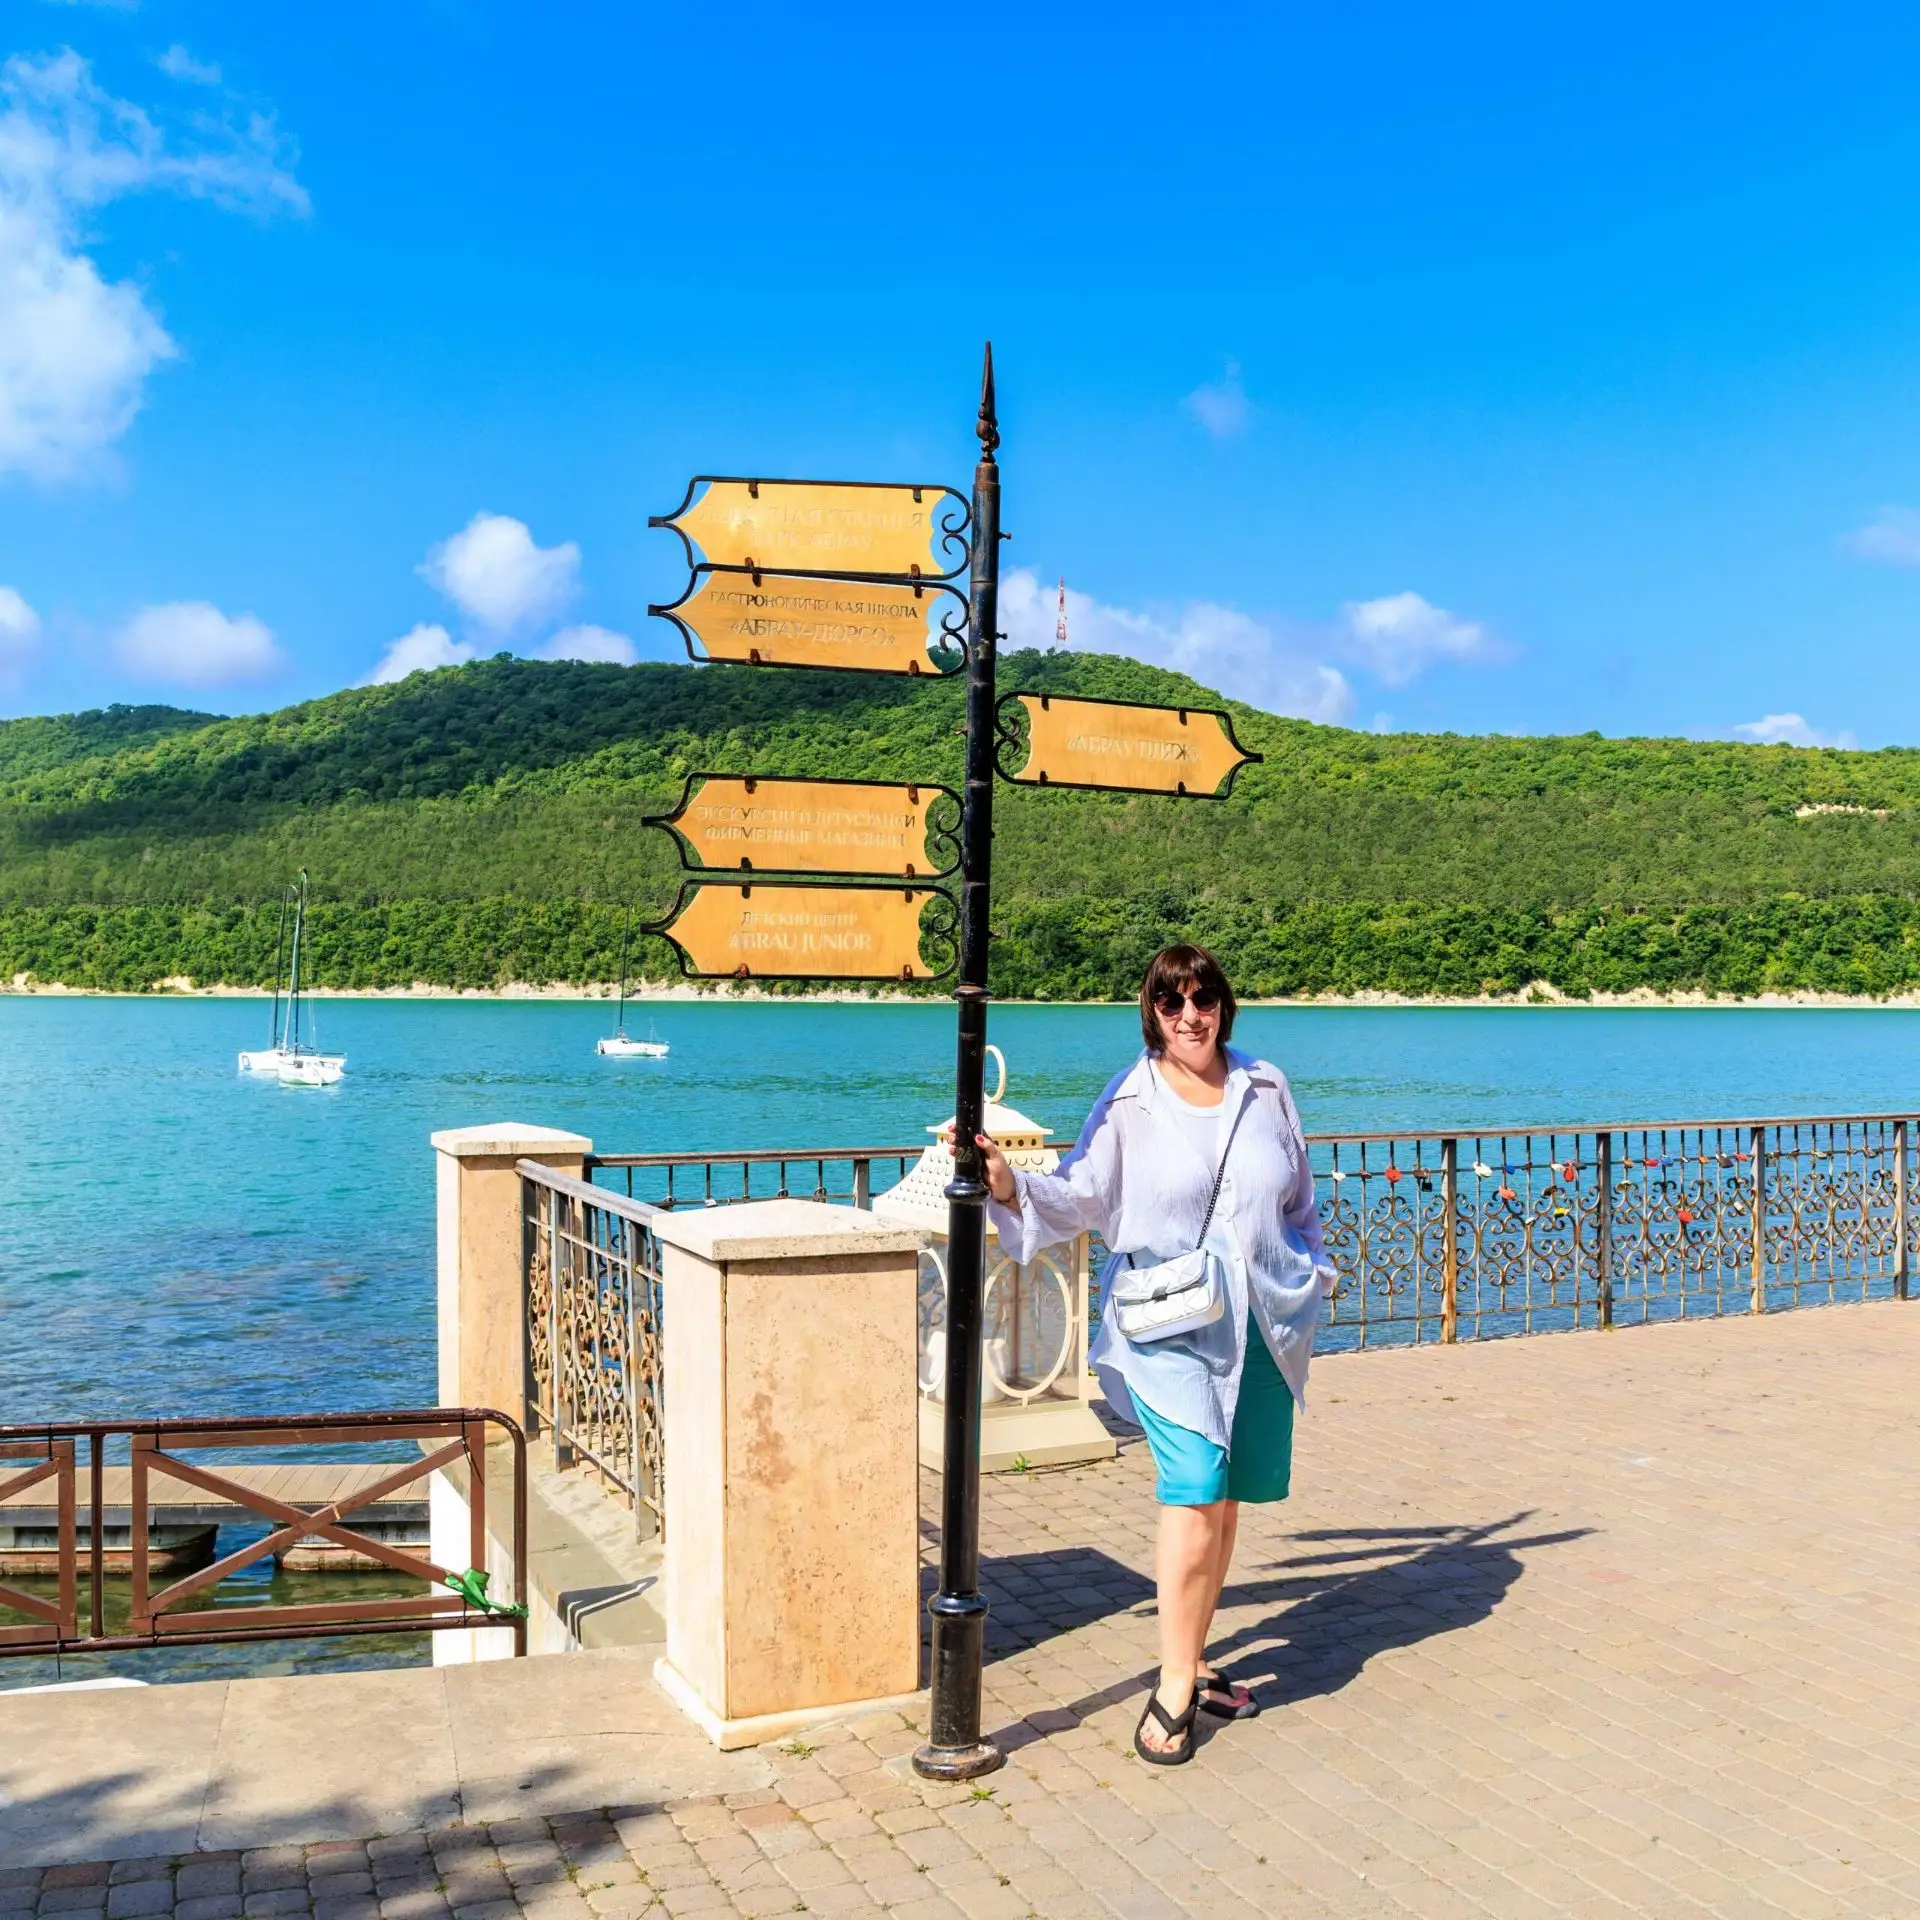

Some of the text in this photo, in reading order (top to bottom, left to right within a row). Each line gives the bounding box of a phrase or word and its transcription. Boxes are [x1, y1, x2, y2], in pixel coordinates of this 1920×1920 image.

[709, 590, 920, 620] ГАСТРОНОМИЧЕСКАЯ ШКОЛА
[730, 617, 897, 645] «АБРАУ-ДЮРСО»
[695, 804, 916, 829] ЭКСКУРСИИ И ДЕГУСТАЦИИ
[704, 825, 906, 848] ФИРМЕННЫЕ МАГАЗИНЫ
[740, 911, 811, 926] ДЕТСКИЙ
[728, 930, 873, 952] ABRAU JUNIOR
